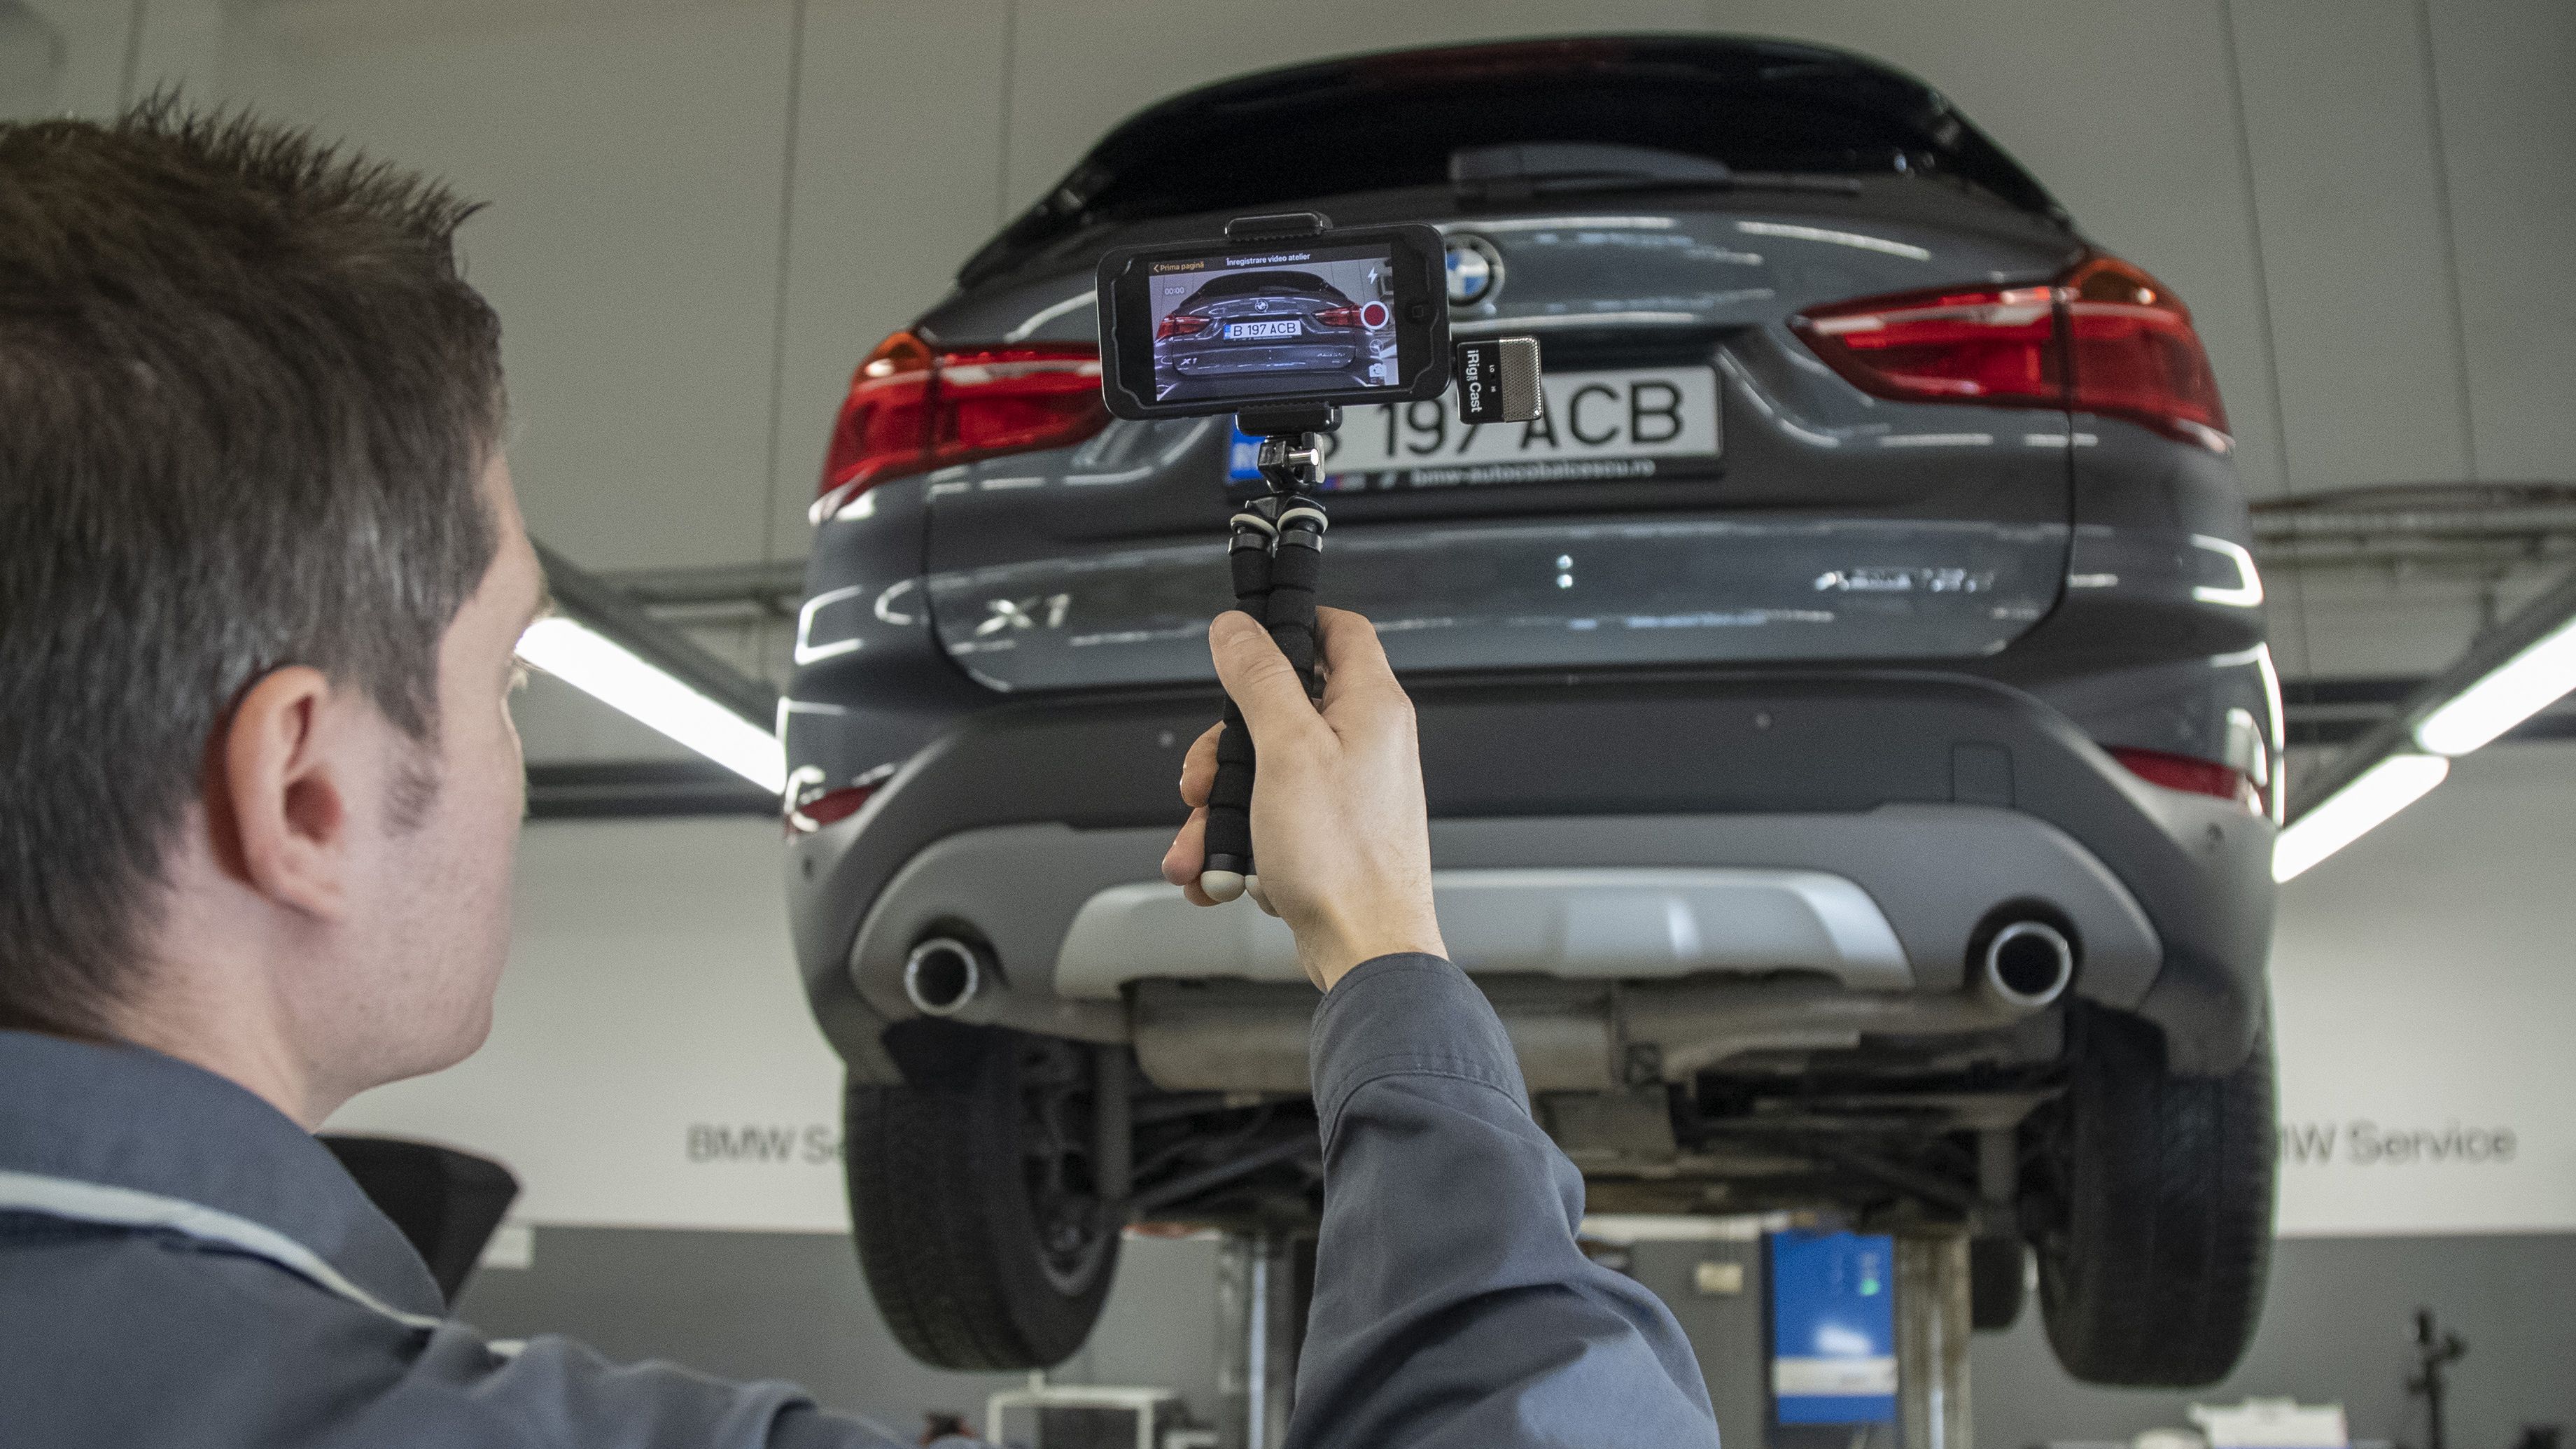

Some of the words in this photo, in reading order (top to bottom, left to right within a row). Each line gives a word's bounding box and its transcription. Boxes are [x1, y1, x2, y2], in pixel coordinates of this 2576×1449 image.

[1160, 263, 1180, 272] Prima
[1181, 261, 1205, 271] pagină
[1226, 256, 1267, 267] Înregistrare
[1268, 255, 1287, 263] video
[1288, 253, 1311, 262] atelier
[1164, 286, 1185, 295] 00:00
[1233, 326, 1242, 337] B
[1248, 323, 1267, 335] 197
[1270, 322, 1296, 334] ACB
[1180, 357, 1198, 365] X1
[1466, 349, 1480, 376] iRig
[1469, 382, 1483, 413] Cast
[1520, 380, 1683, 449] ACB
[975, 593, 1070, 637] X1
[685, 1123, 796, 1163] BMW
[2348, 1119, 2518, 1166] Service
